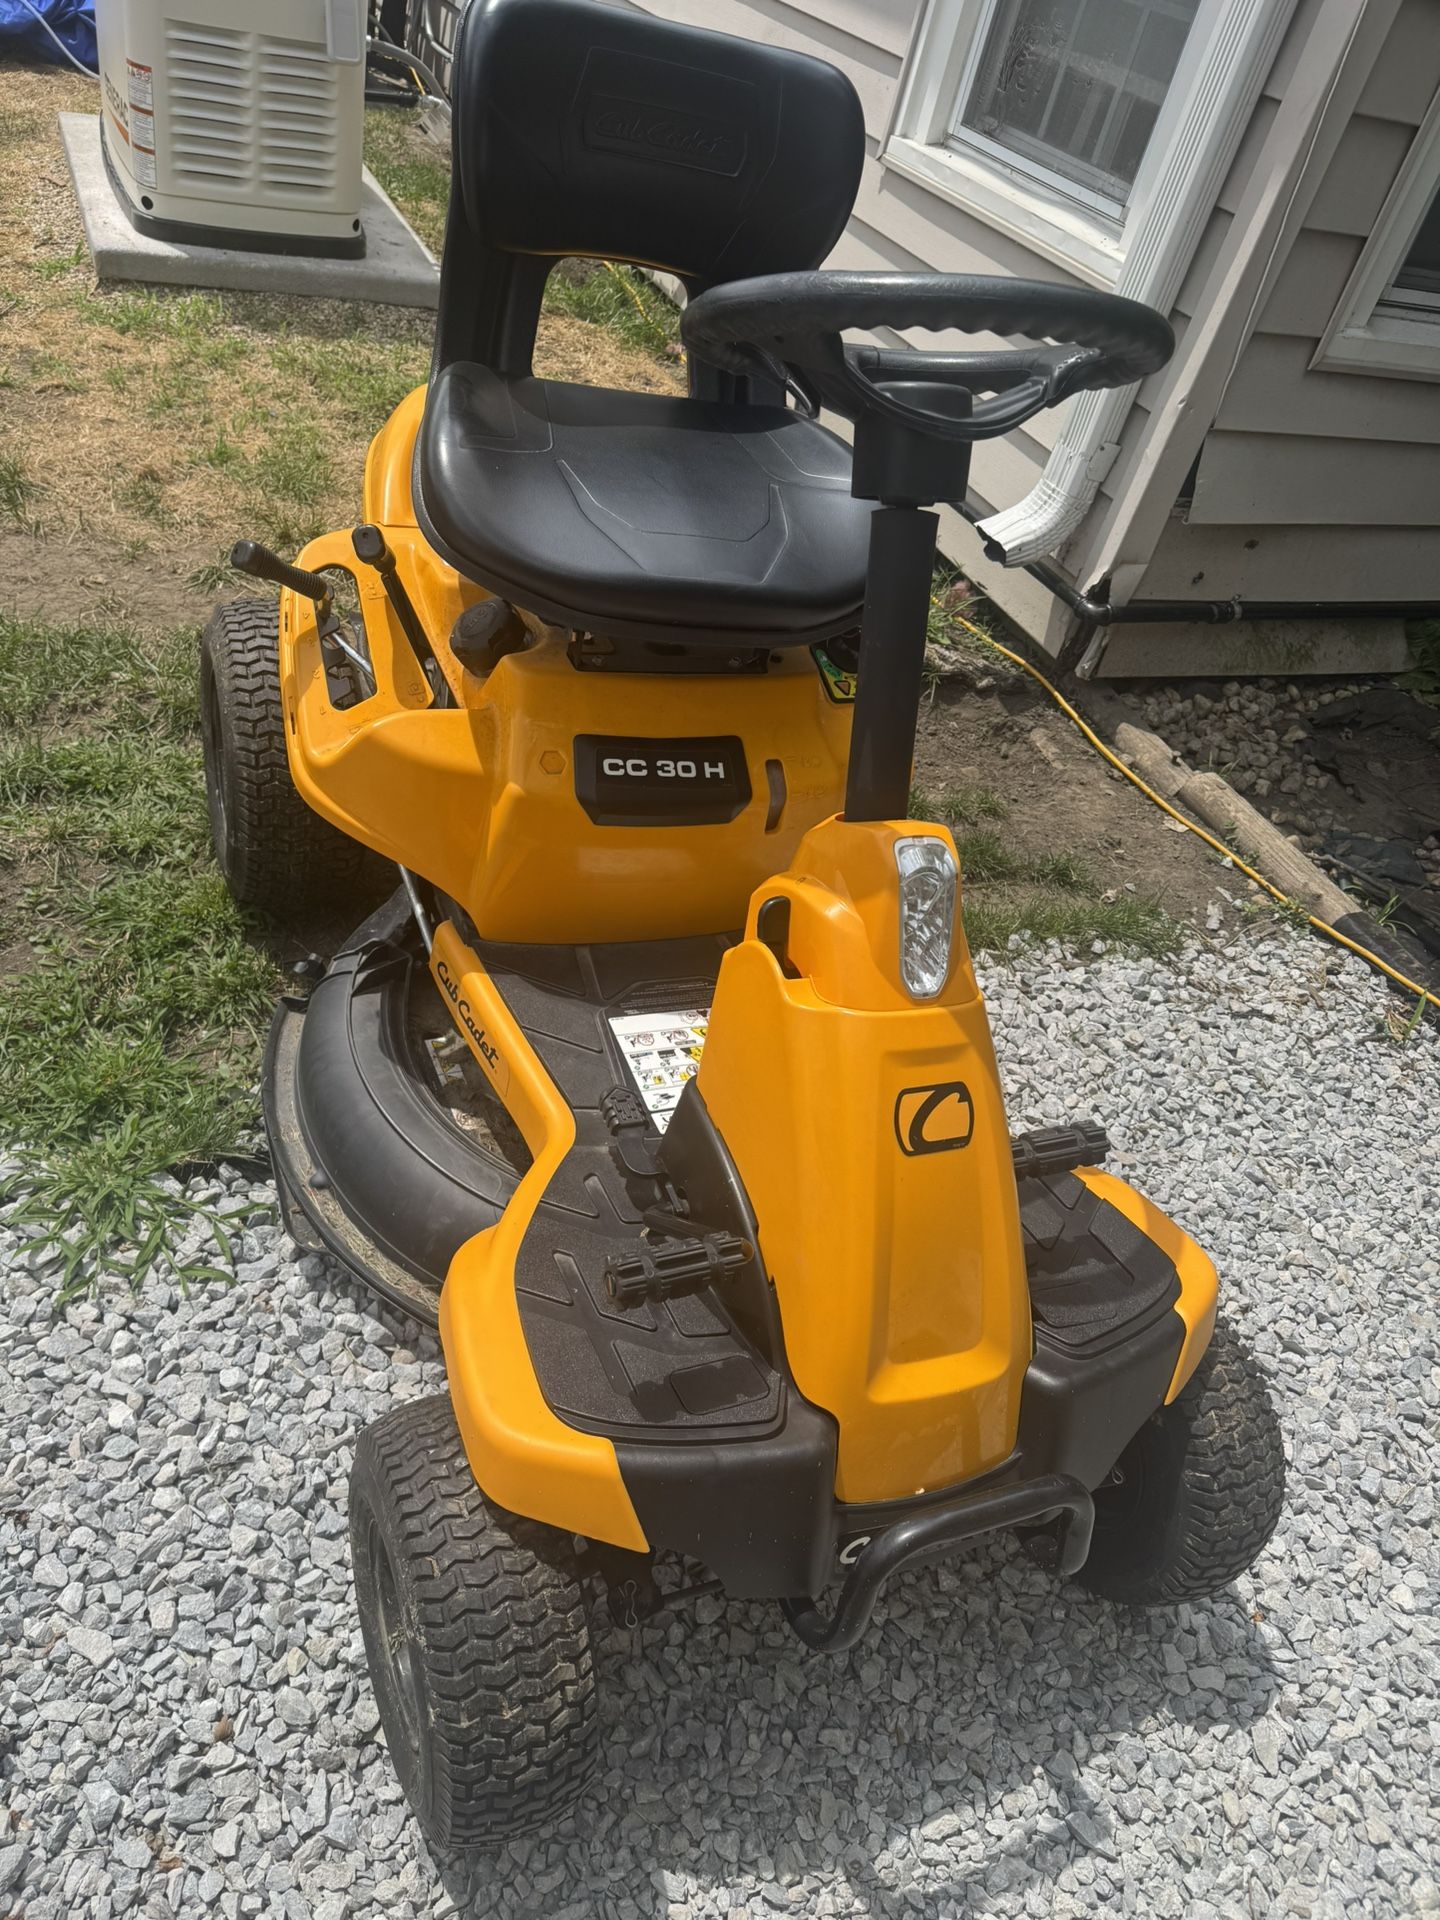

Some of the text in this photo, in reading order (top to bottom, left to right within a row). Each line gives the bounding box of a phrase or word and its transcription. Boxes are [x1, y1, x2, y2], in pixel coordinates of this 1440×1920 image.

[603, 758, 725, 779] CC 30 H
[437, 961, 500, 1070] Cub Cadet
